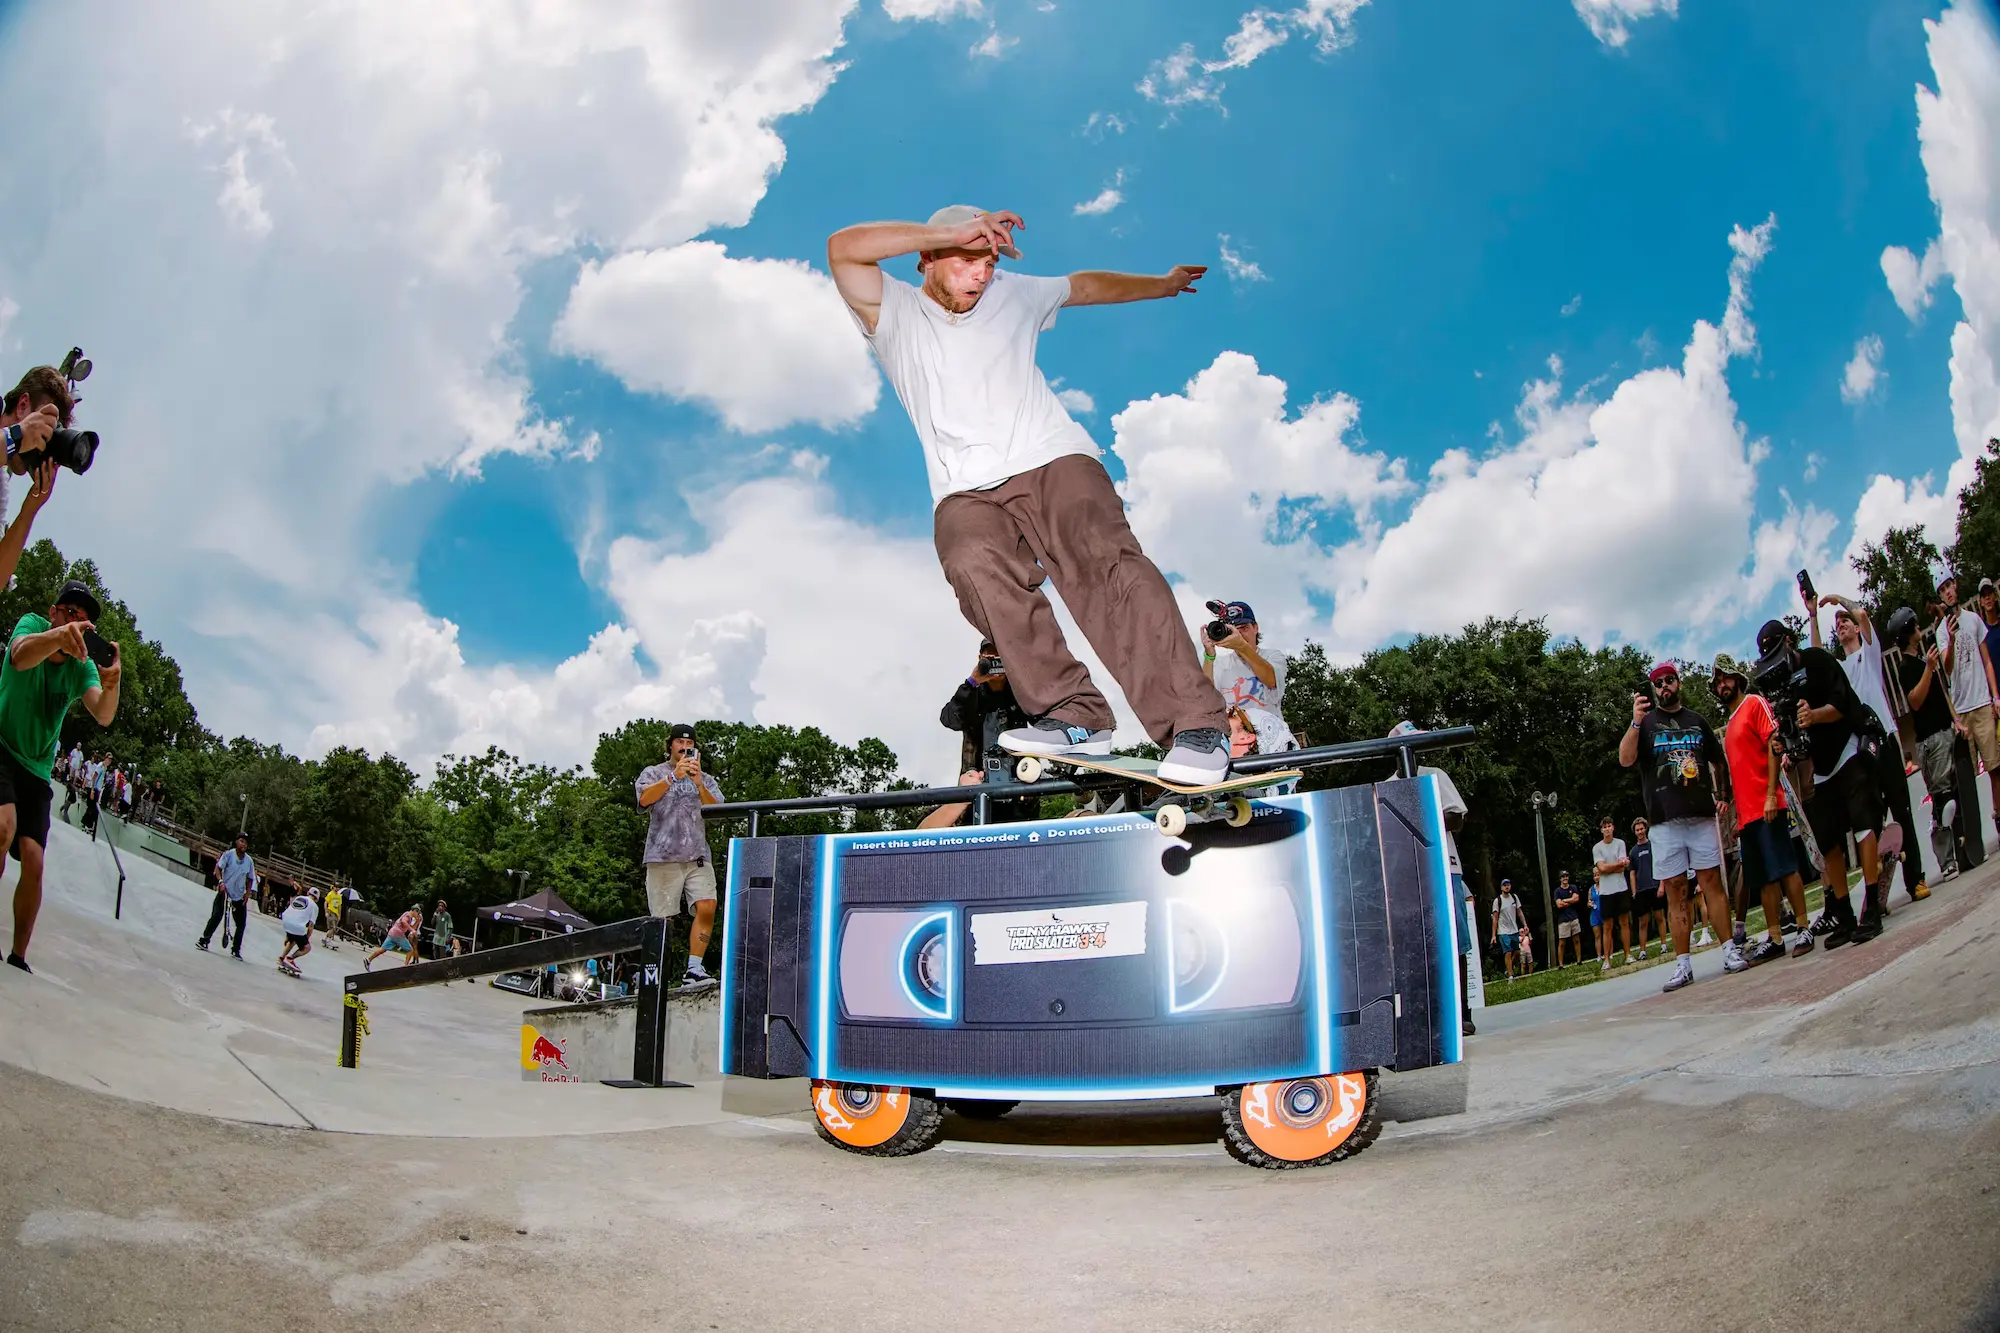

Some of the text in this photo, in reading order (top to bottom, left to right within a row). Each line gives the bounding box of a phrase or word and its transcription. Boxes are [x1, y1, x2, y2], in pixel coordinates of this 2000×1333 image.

[1048, 822, 1158, 838] Do not touch tap
[852, 833, 1021, 850] Insert this side into recorder
[1006, 922, 1109, 938] TONY HAWK'S
[1009, 936, 1035, 950] PRO
[1033, 934, 1080, 950] SKATER
